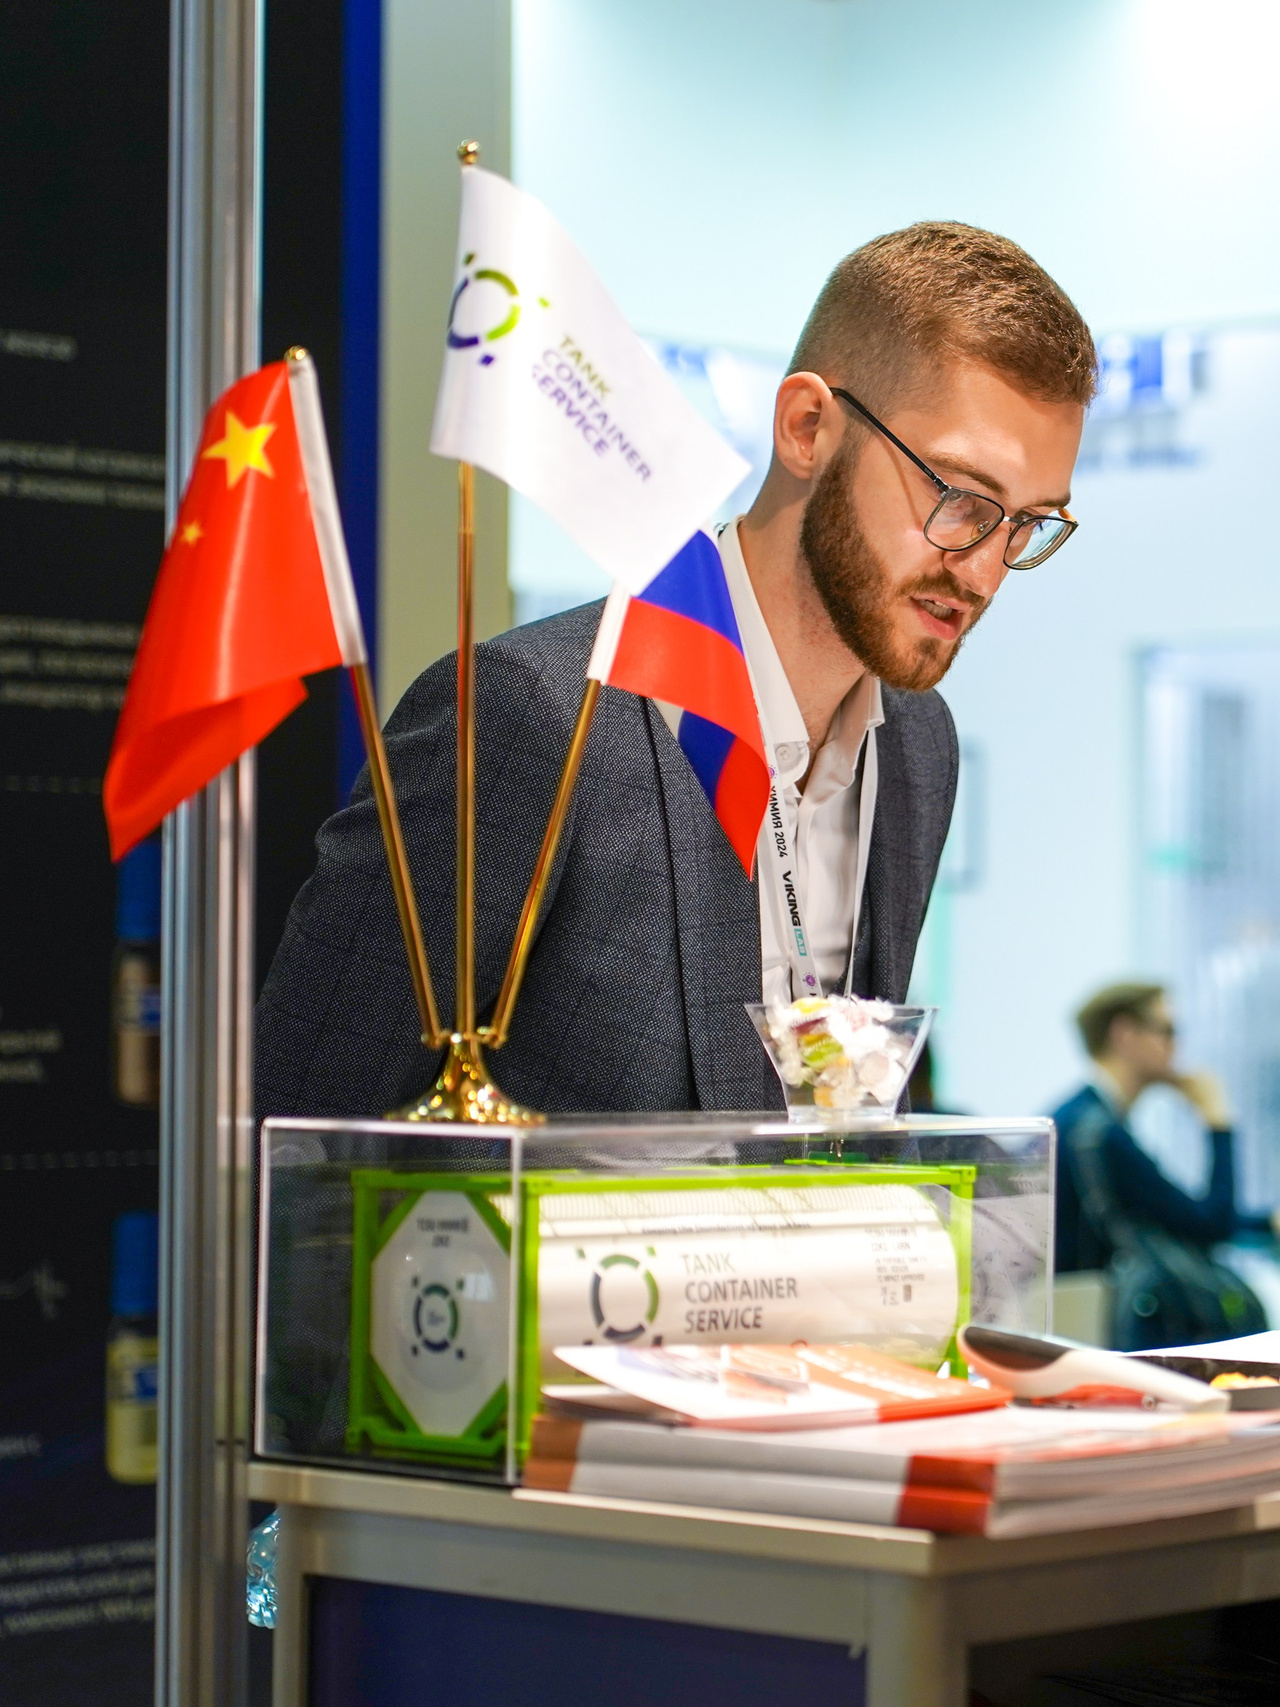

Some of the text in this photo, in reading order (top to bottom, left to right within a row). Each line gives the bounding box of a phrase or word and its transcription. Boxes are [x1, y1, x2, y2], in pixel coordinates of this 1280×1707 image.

[560, 336, 611, 396] TANK
[542, 349, 653, 482] CONTAINER
[774, 831, 788, 858] 2024
[782, 870, 801, 927] VIKING
[680, 1252, 736, 1275] TANK
[684, 1277, 798, 1304] CONTAINER
[684, 1306, 762, 1334] SERVICE
